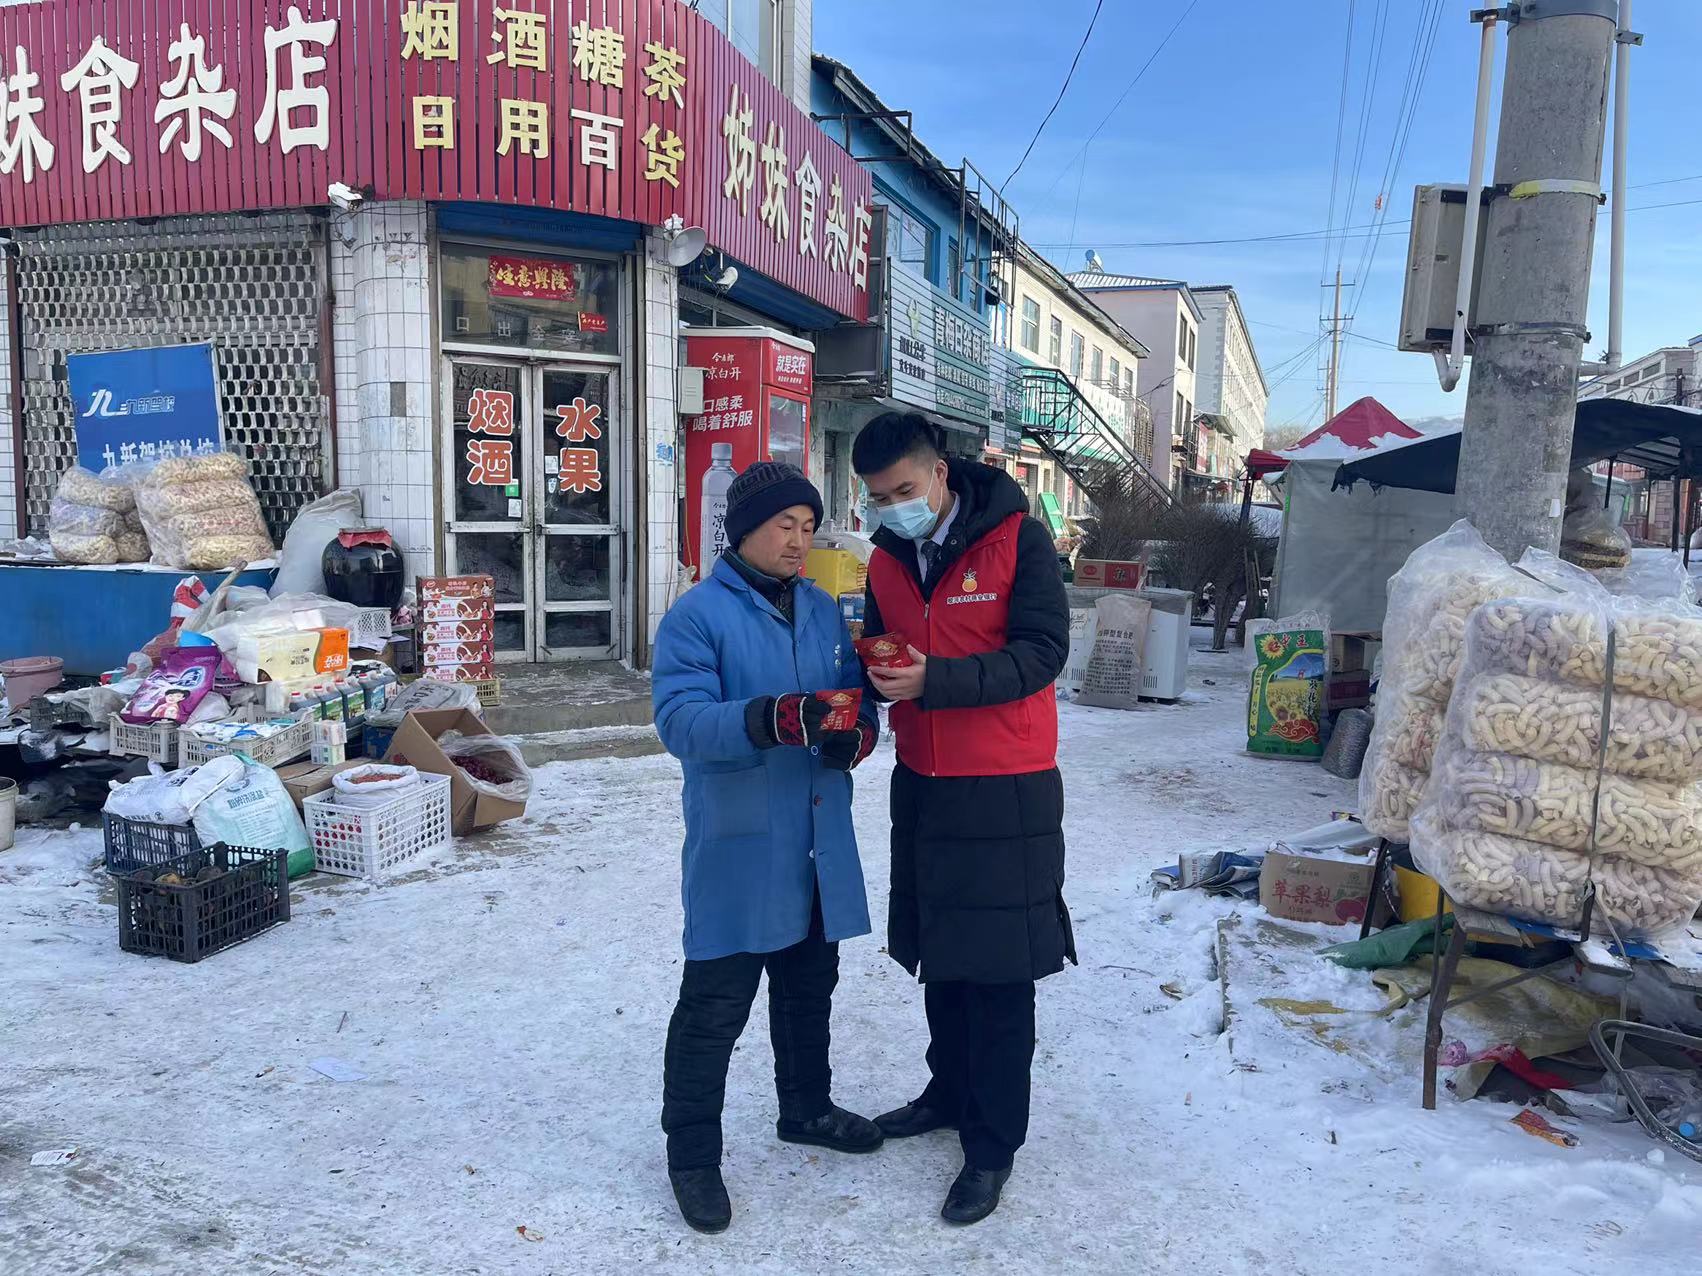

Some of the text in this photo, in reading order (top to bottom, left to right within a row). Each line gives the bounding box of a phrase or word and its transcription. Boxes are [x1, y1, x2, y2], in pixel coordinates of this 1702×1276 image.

[0, 5, 338, 184] 妹食杂店
[400, 1, 687, 109] 烟酒糖茶
[412, 95, 686, 189] 日用百货
[467, 388, 513, 486] 烟酒
[556, 397, 602, 494] 水果
[692, 409, 753, 432] 喝着舒服
